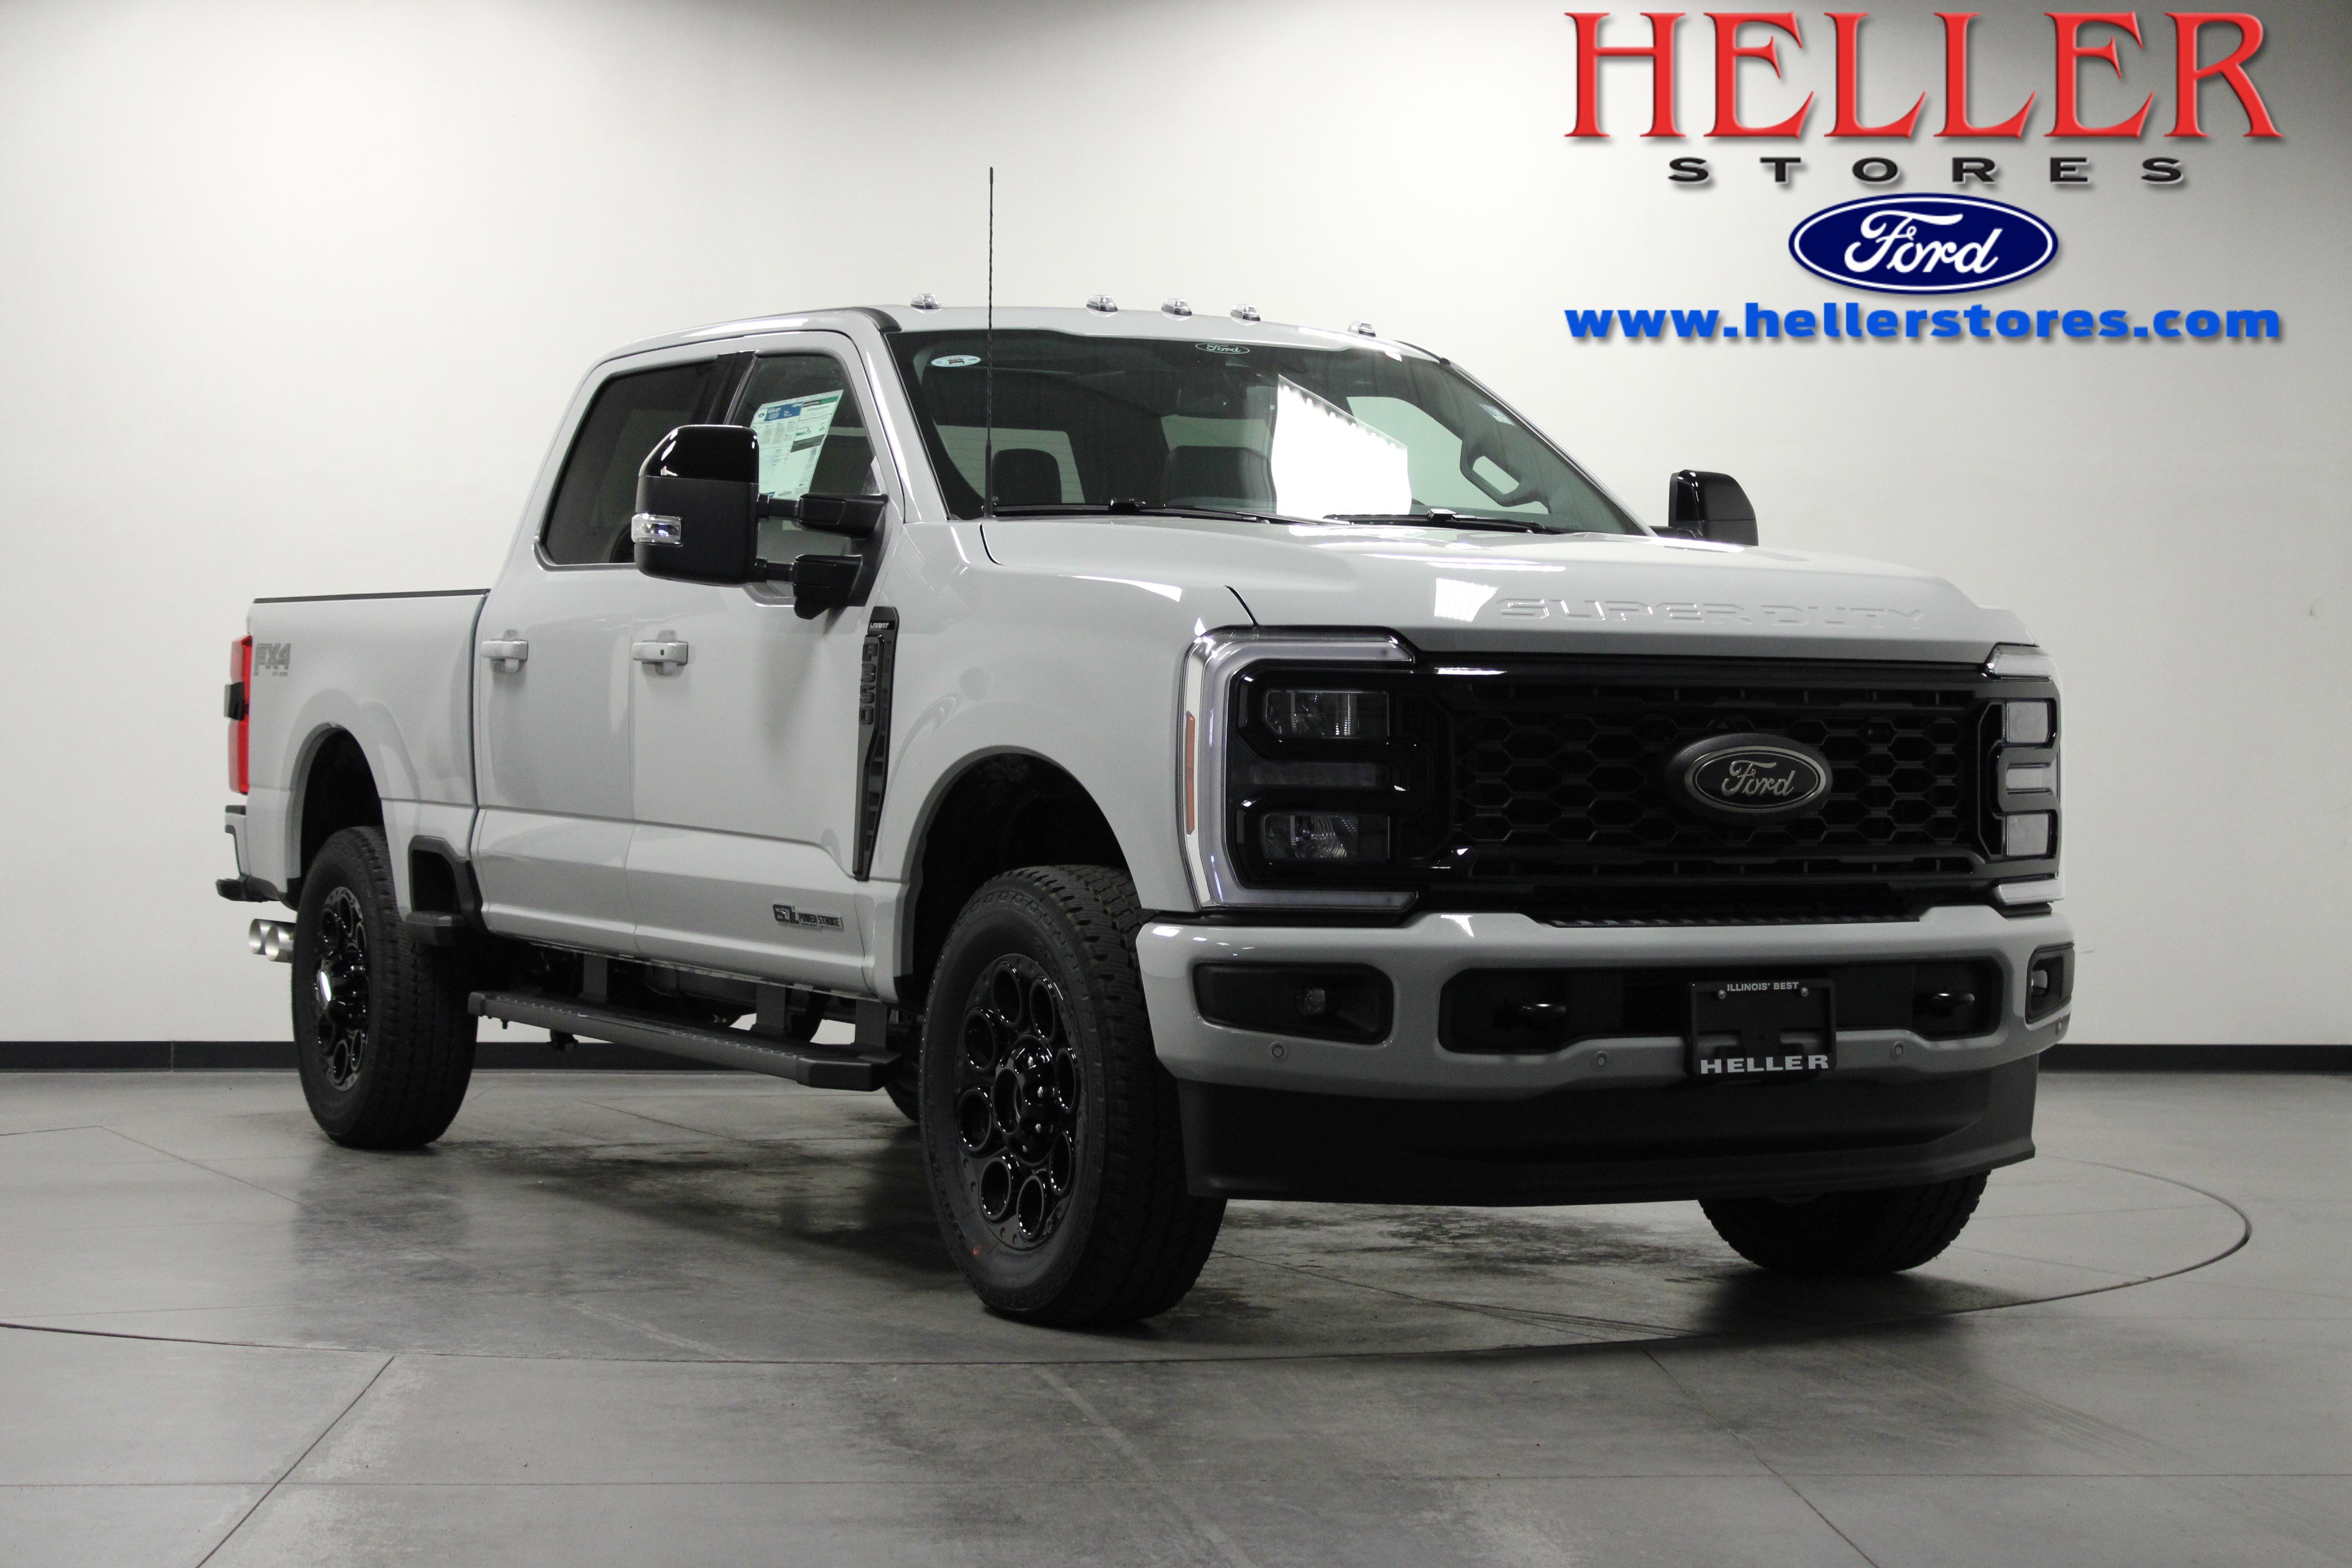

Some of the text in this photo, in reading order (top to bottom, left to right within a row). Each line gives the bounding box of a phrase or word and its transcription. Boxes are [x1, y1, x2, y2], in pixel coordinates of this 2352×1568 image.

[1206, 344, 1241, 353] Ford
[1497, 598, 1923, 630] SUPER DUTY
[1721, 759, 1796, 797] Ford
[1773, 981, 1799, 991] BEST
[1700, 1054, 1829, 1074] HELLER
